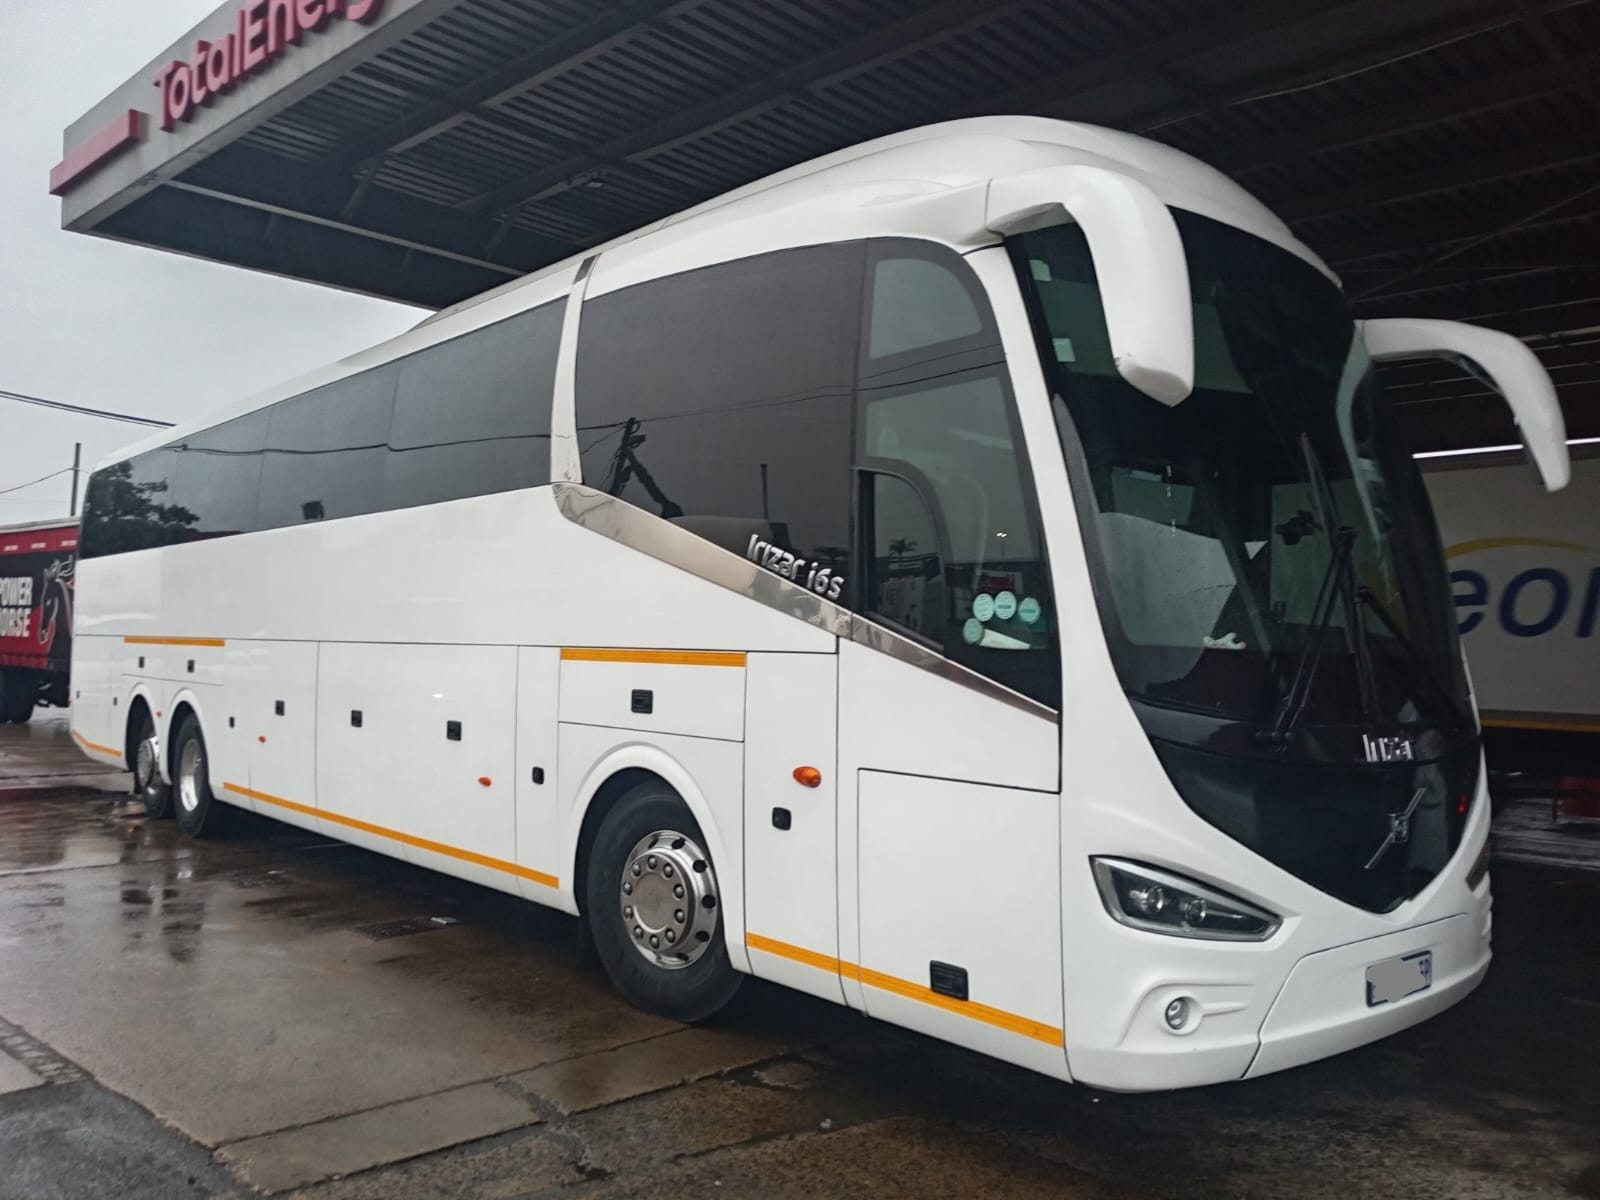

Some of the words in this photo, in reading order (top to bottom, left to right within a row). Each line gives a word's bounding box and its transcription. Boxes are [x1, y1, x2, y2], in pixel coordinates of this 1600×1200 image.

[746, 533, 806, 580] Irizar
[806, 561, 845, 600] i6s
[1448, 566, 1600, 638] eo
